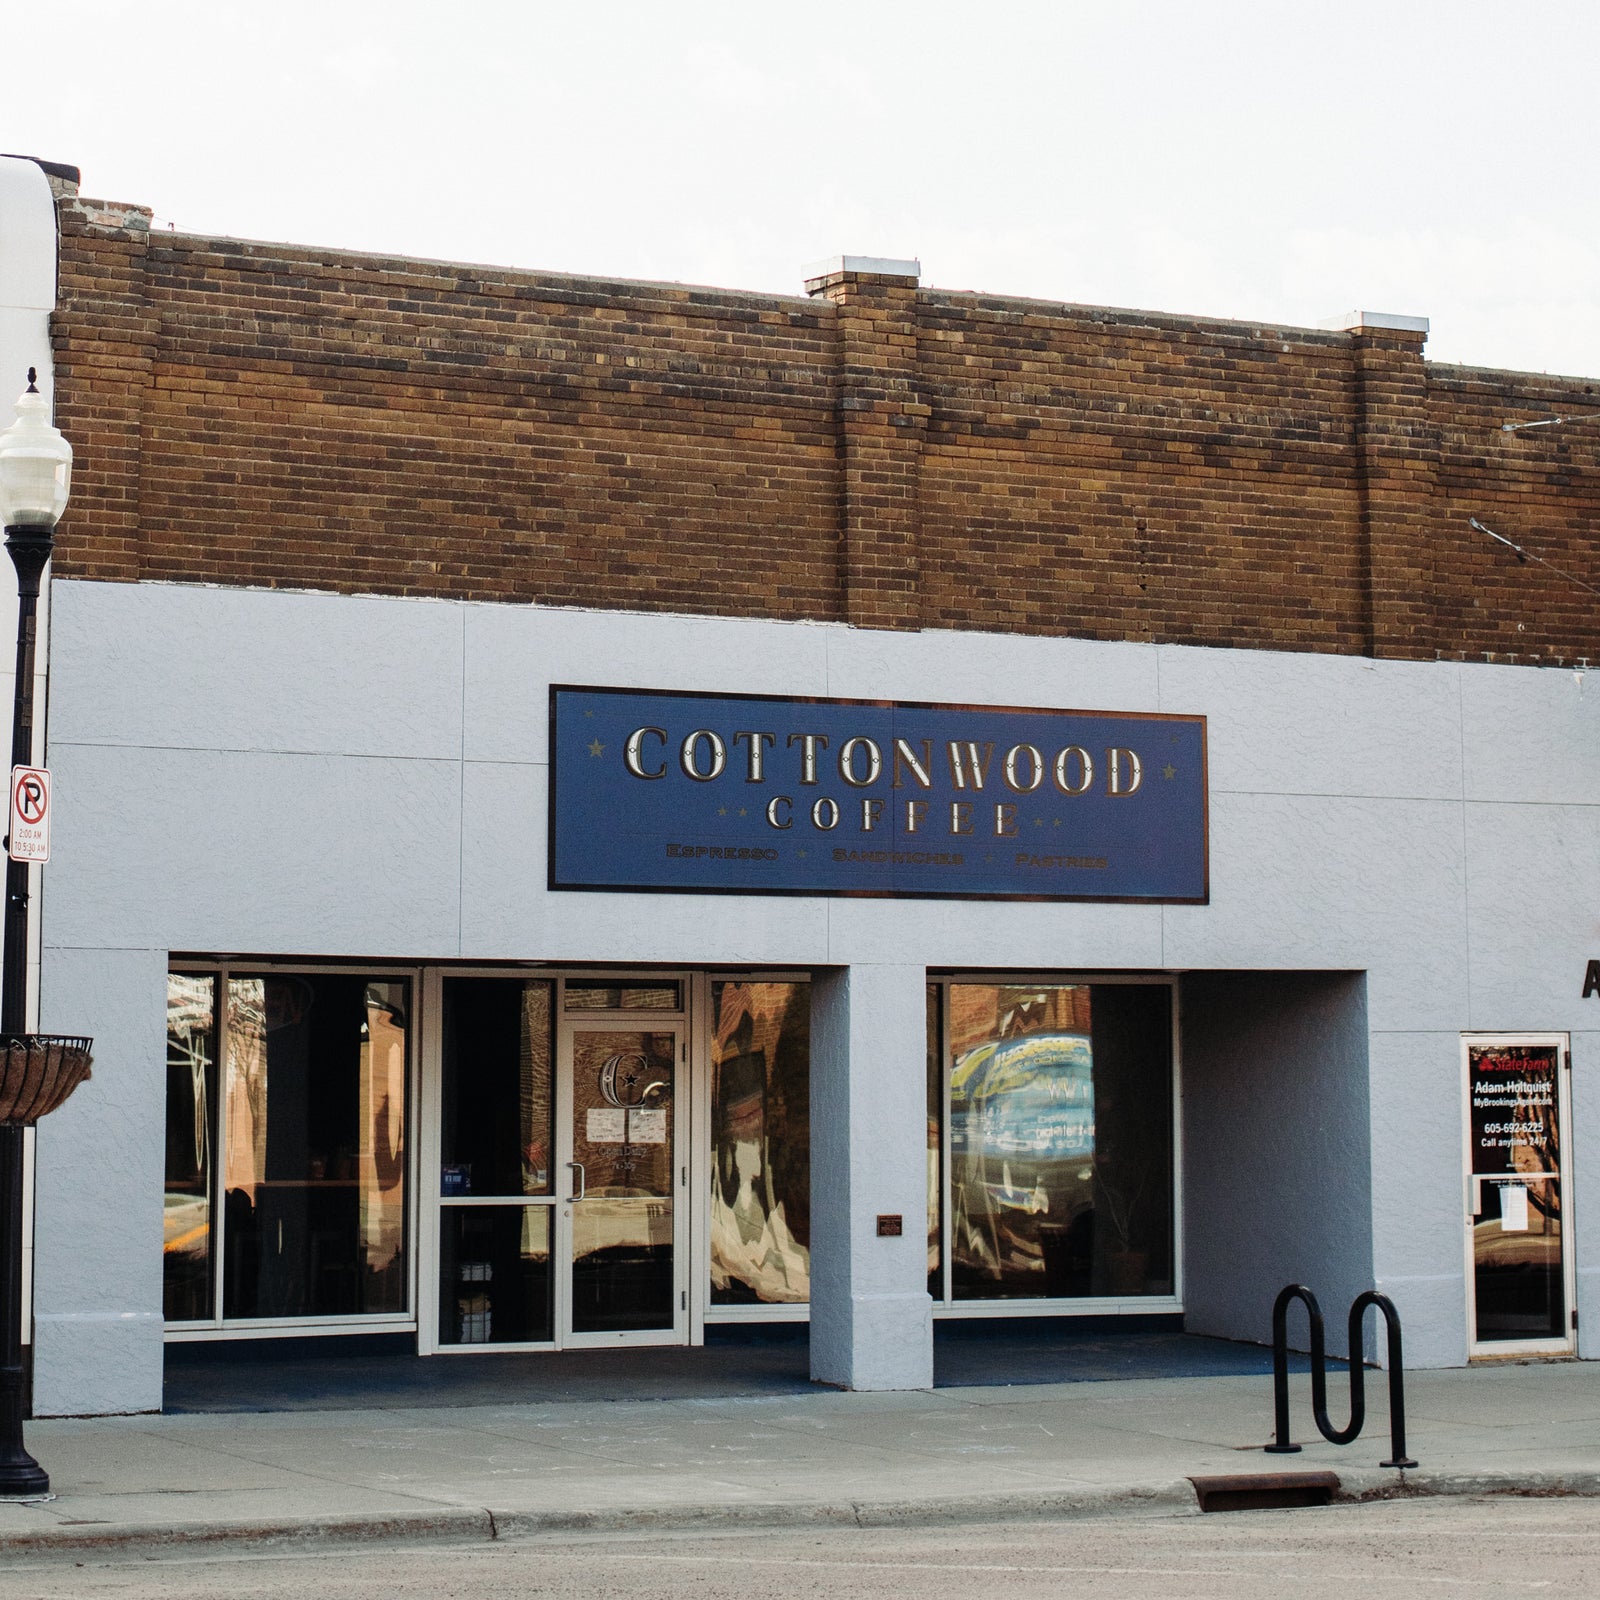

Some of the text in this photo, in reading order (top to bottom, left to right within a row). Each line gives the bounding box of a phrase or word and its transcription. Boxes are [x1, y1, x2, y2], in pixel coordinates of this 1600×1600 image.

[623, 726, 1144, 797] COTTONWOOD
[765, 795, 1019, 837] COFFEE
[19, 828, 42, 840] 2:00 AM
[15, 841, 21, 851] TO
[23, 842, 35, 853] 5:30
[1475, 1081, 1504, 1094] Adam
[1484, 1122, 1543, 1134] 605-692-6225
[1481, 1136, 1547, 1148] Call anytime 24/7
